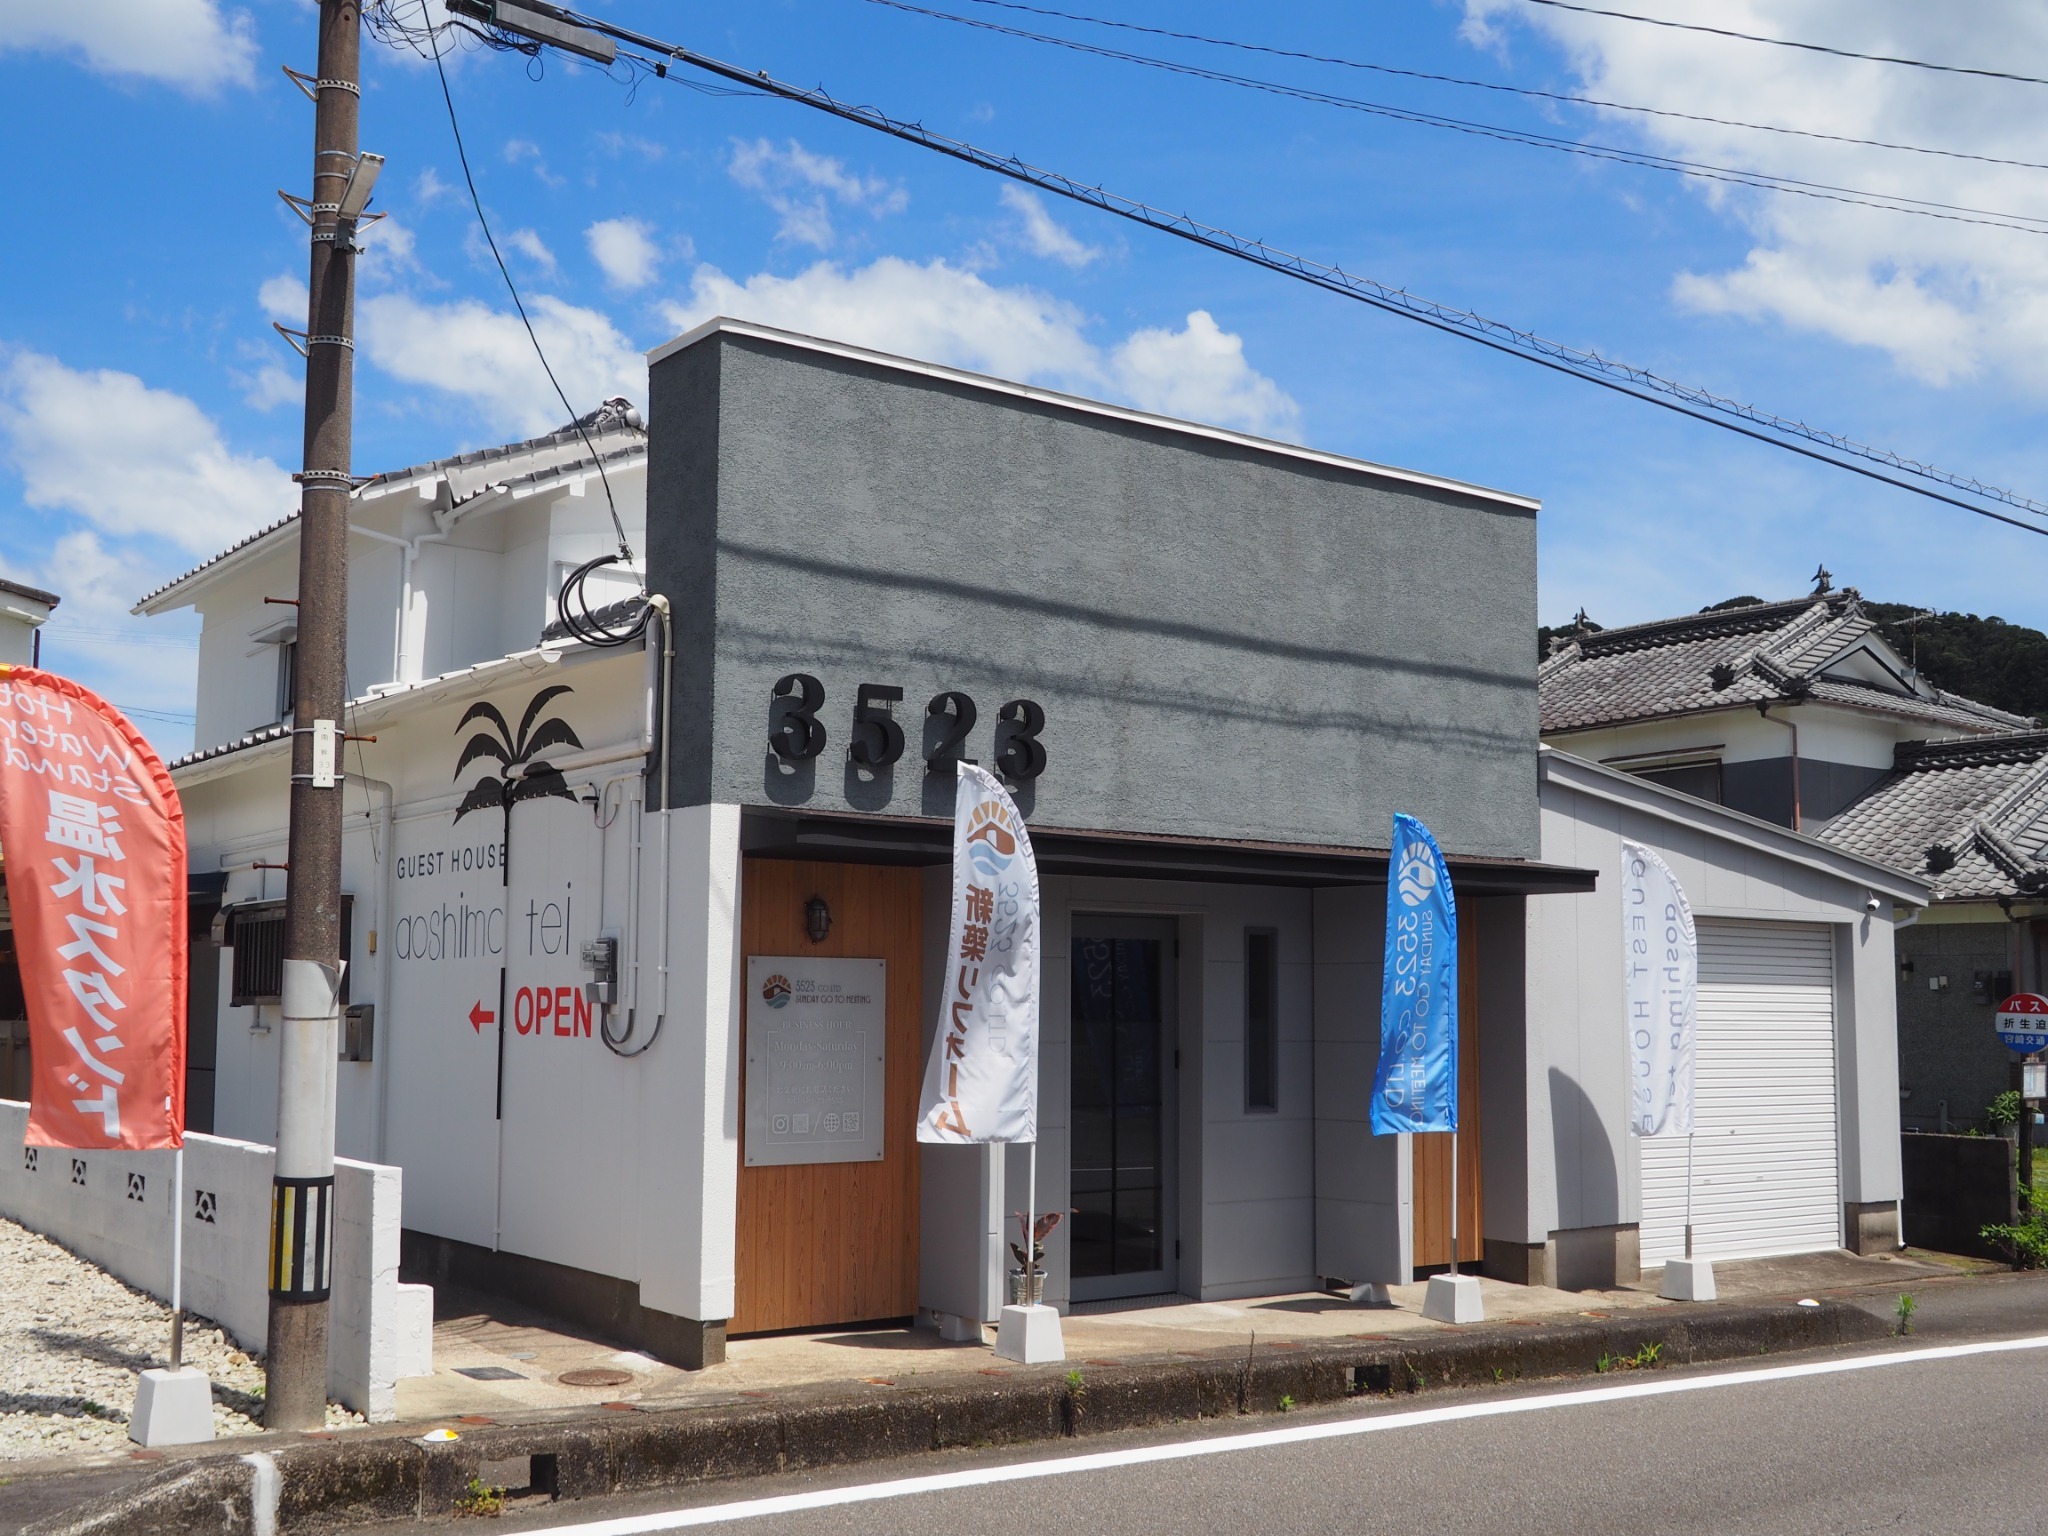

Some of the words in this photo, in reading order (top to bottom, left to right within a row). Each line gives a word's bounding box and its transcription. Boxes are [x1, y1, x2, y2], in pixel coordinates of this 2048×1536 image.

[770, 674, 1046, 779] 3523
[397, 851, 444, 879] GUEST
[451, 843, 505, 873] HOUSE
[526, 881, 571, 956] tei
[796, 980, 815, 992] 3523
[796, 995, 819, 1003] SUNDAY
[821, 995, 833, 1003] GO
[835, 995, 845, 1003] TO
[514, 986, 593, 1038] OPEN
[2009, 1000, 2041, 1012] バス
[2003, 1018, 2047, 1030] 折生迫
[2004, 1035, 2046, 1046] 宮崎交通
